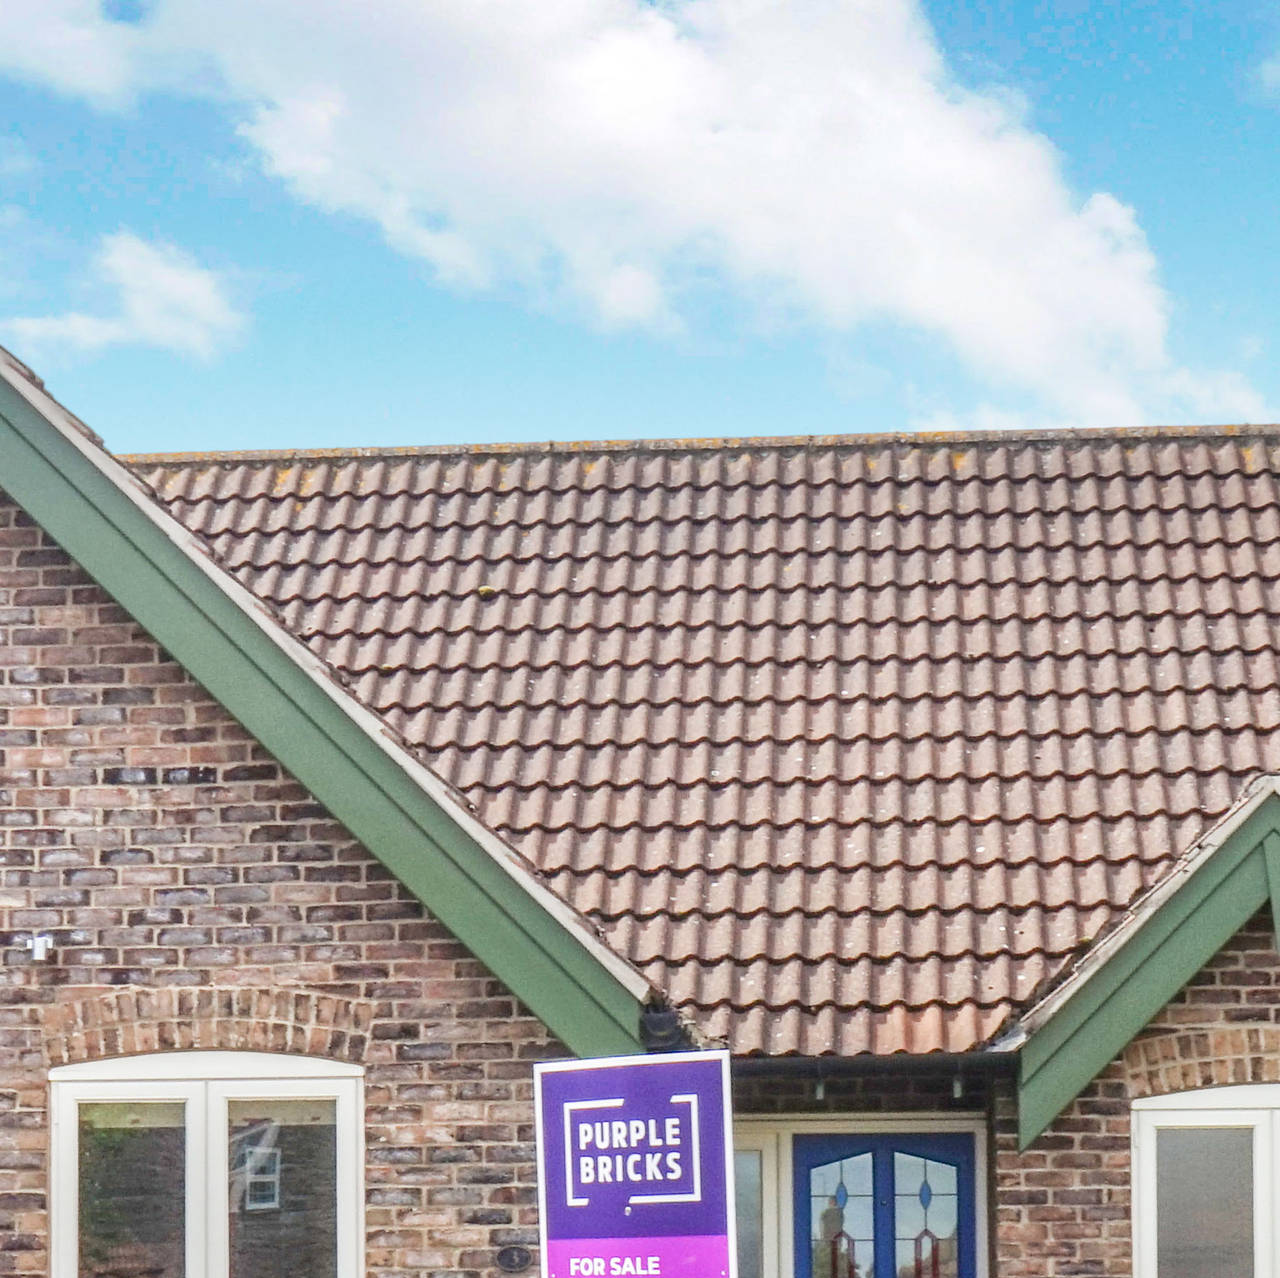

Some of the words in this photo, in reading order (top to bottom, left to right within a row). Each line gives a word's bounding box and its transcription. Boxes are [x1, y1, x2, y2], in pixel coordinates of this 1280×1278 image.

[578, 1117, 681, 1150] PURPLE
[579, 1152, 682, 1183] BRICKS
[569, 1257, 606, 1276] FOR
[609, 1256, 661, 1275] SALE
